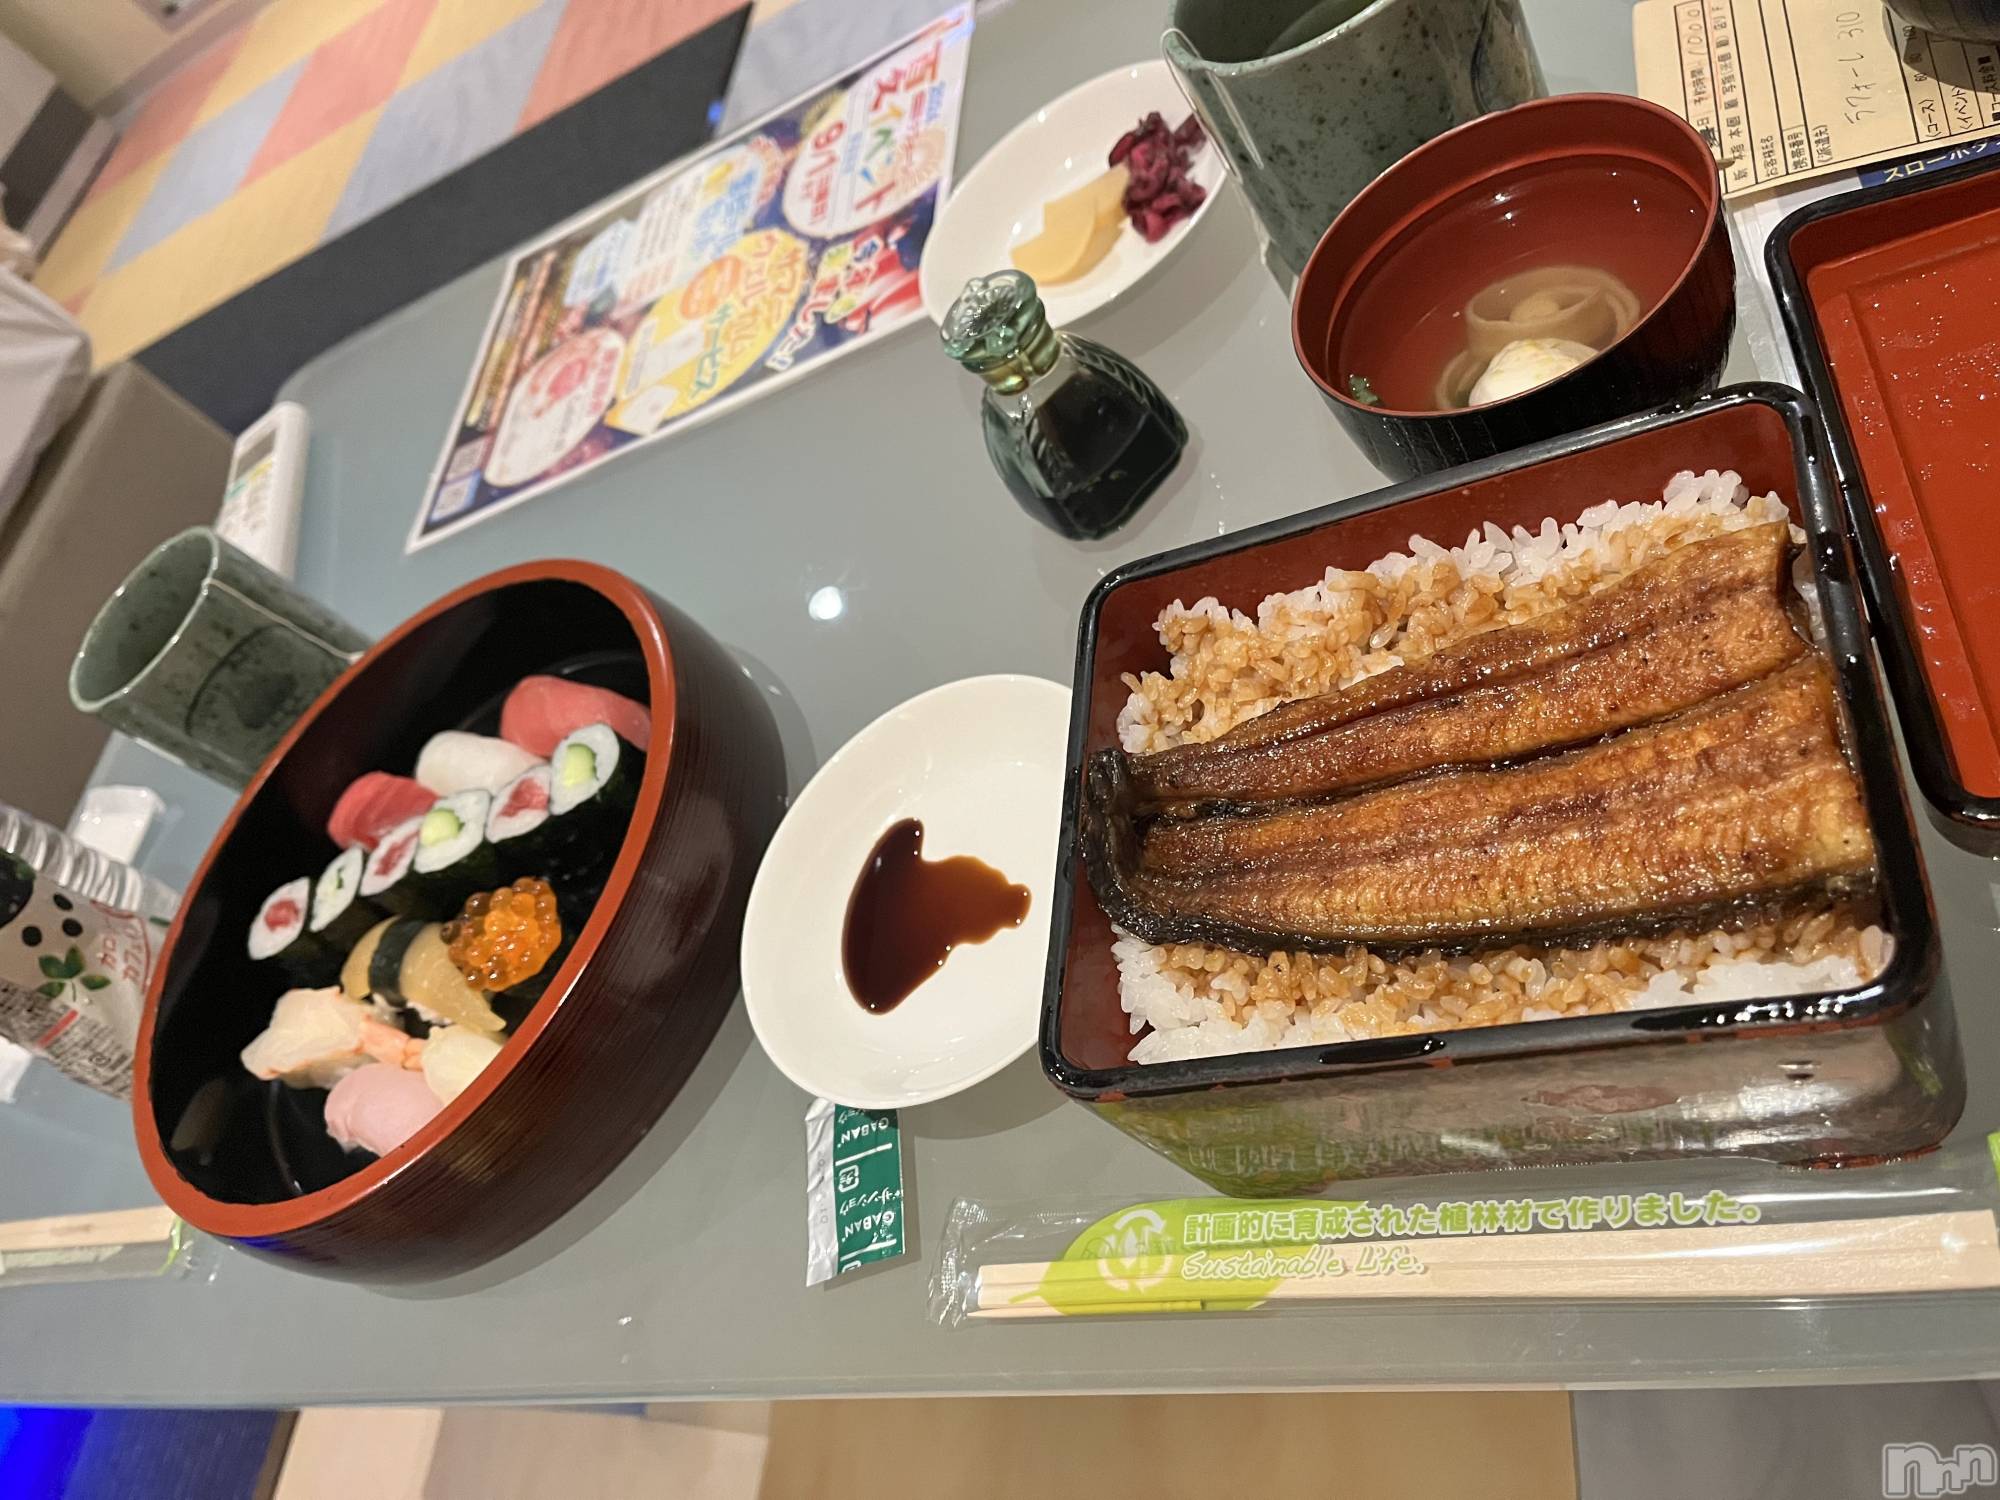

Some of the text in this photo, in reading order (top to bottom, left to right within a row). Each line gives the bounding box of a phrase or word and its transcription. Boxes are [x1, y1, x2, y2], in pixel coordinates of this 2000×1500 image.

[1760, 135, 1779, 177] お客様氏名
[1787, 132, 1808, 169] 携帯番号
[841, 1117, 890, 1145] GABAN
[843, 1210, 896, 1237] GABAN
[1183, 1190, 1763, 1246] 計画的に育成された植林材で作りました。
[1181, 1240, 1427, 1281] Sustainable Life.
